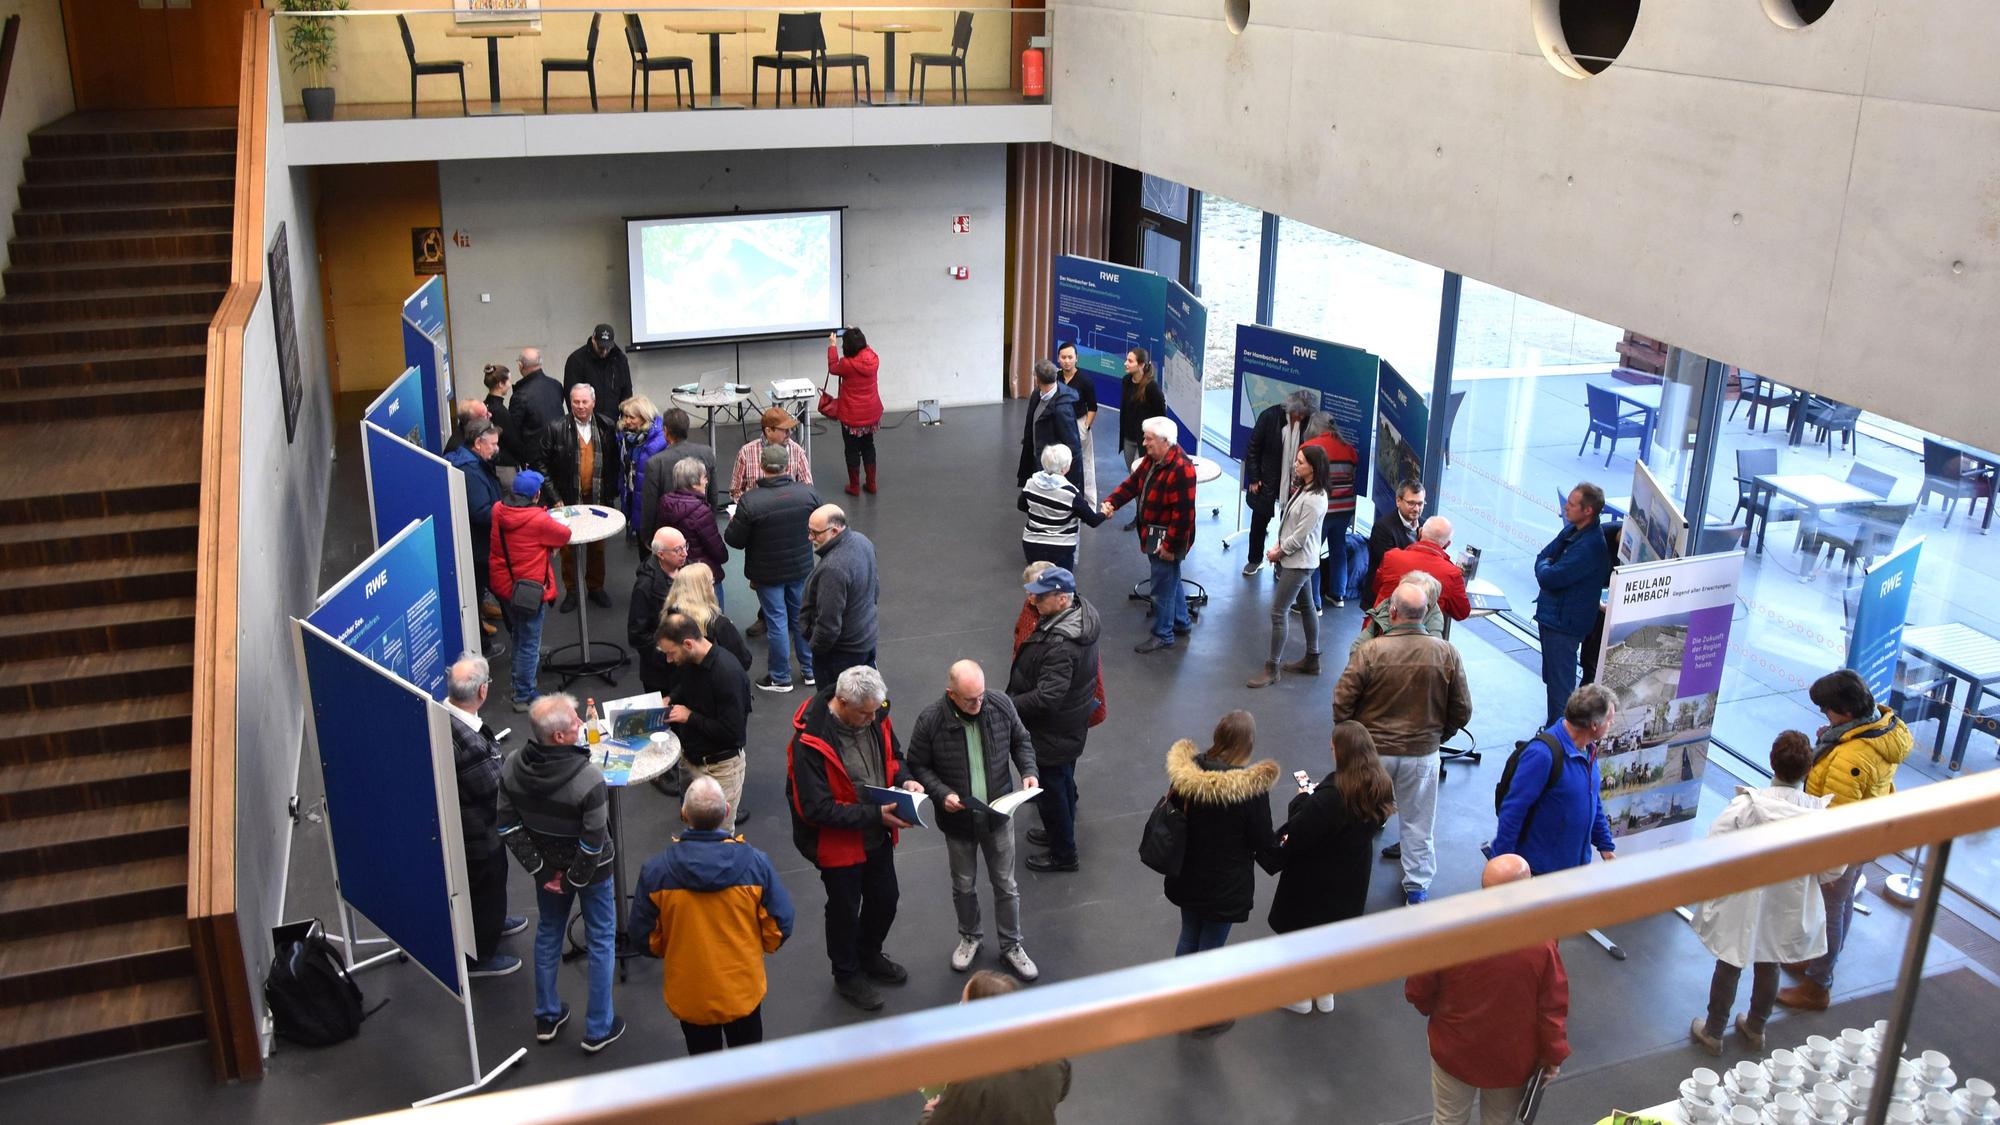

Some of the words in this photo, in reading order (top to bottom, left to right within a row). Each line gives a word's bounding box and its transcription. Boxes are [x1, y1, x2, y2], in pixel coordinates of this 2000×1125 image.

[1099, 271, 1120, 283] RWE
[1293, 345, 1318, 361] RWE
[365, 569, 388, 599] RWE
[1625, 575, 1672, 592] NEULAND
[1879, 570, 1904, 598] RWE
[1623, 588, 1670, 604] HAMBACH
[1672, 589, 1690, 597] Gegend
[1692, 637, 1702, 645] Die
[1702, 633, 1724, 643] Zukunft
[1691, 645, 1702, 654] der
[1702, 642, 1722, 652] Region
[1694, 651, 1716, 661] beginnt
